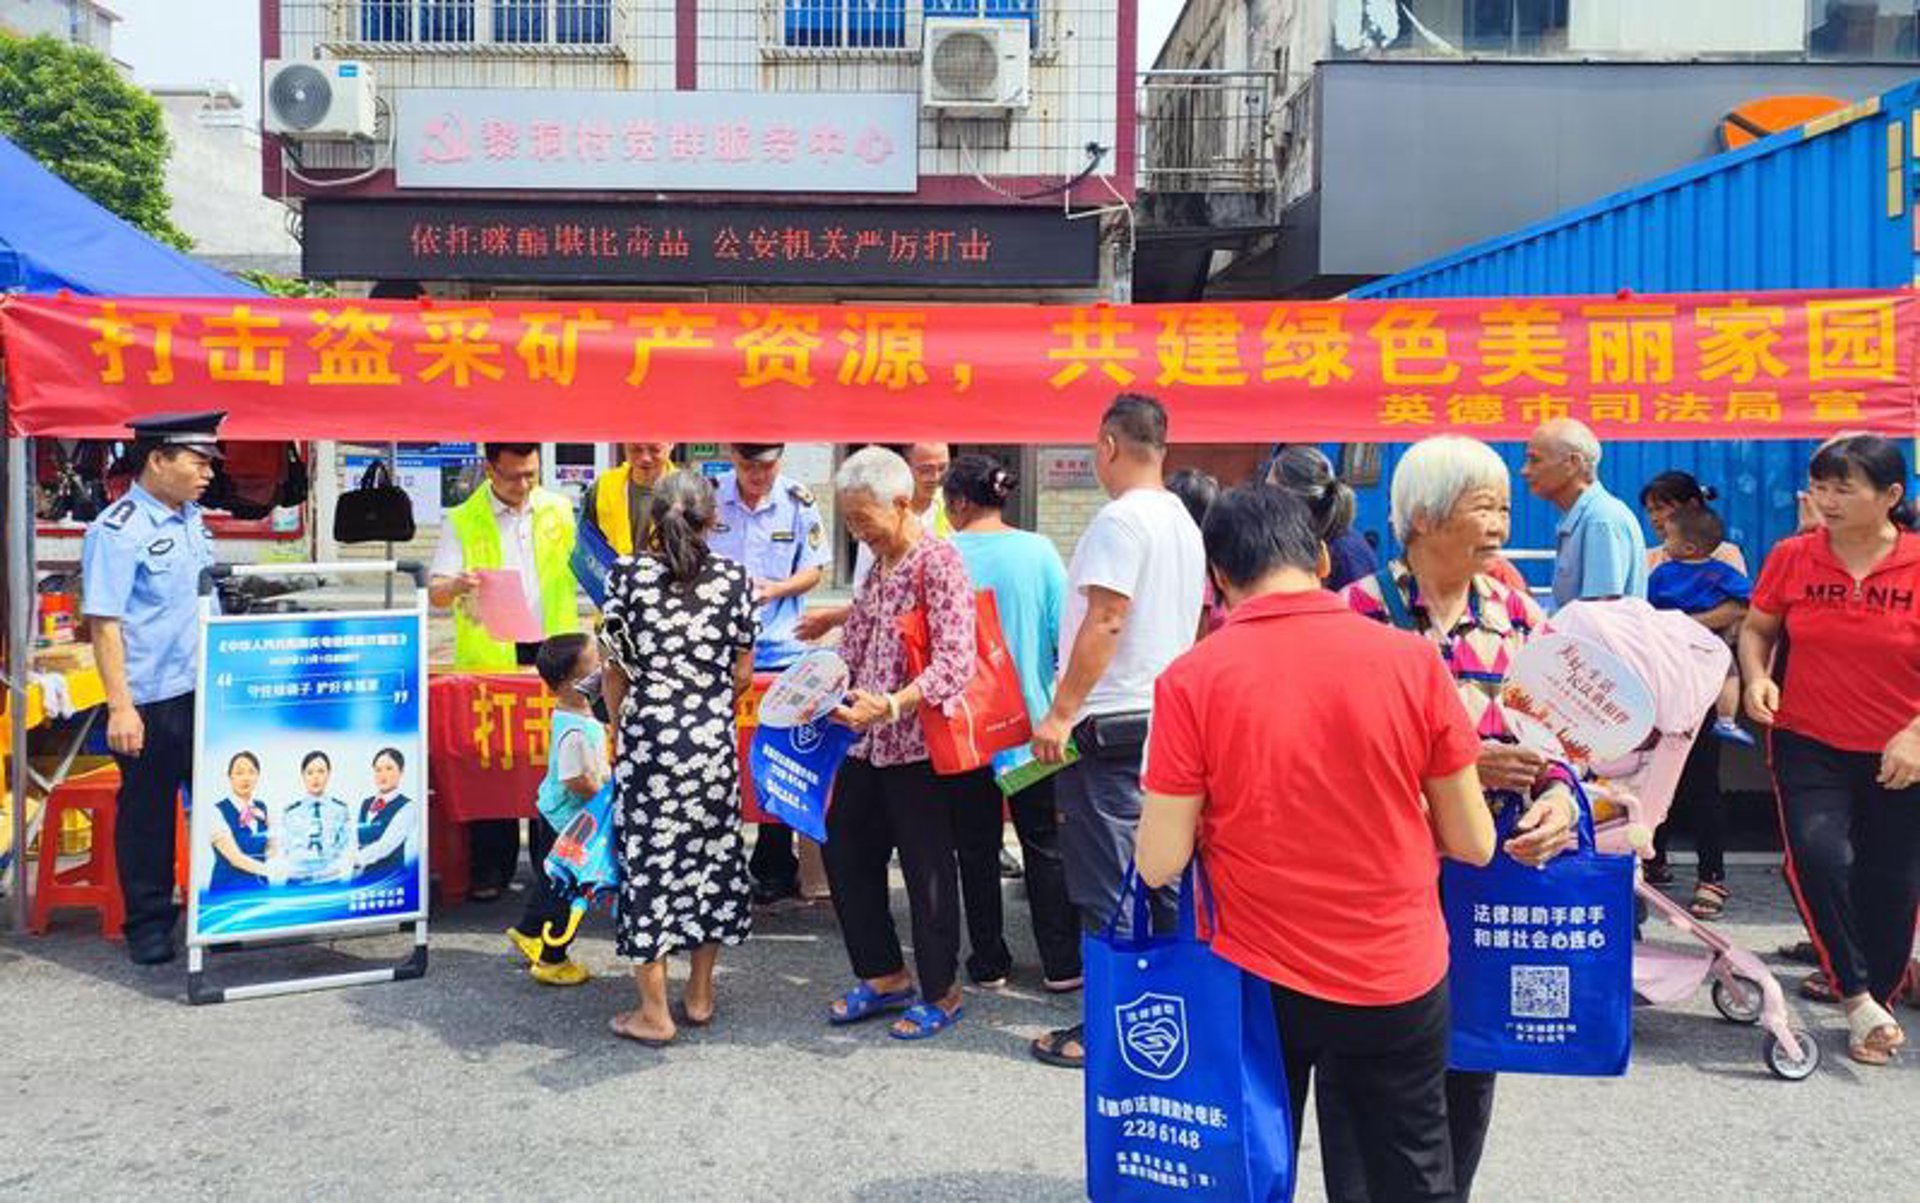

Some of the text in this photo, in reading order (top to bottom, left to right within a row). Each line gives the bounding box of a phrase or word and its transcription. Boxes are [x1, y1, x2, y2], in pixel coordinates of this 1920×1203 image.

[713, 226, 992, 262] 公安机关严厉打击
[1473, 928, 1606, 949] 和谐社会心连心
[1123, 1119, 1200, 1150] 2286148
